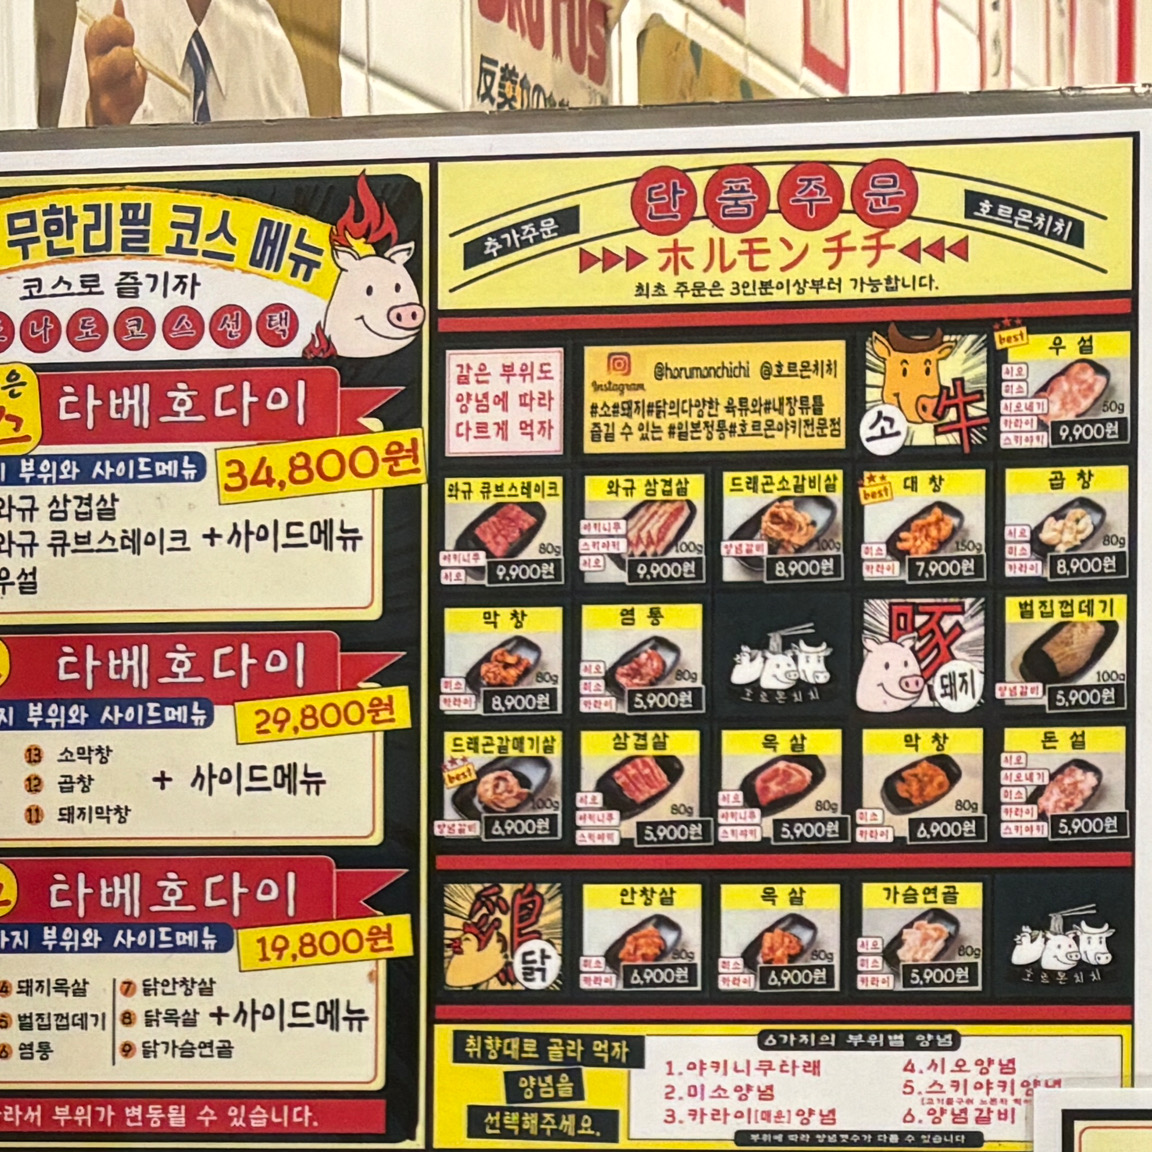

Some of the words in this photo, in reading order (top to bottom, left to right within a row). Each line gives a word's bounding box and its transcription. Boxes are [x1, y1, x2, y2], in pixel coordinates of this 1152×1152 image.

[645, 172, 908, 222] 단품주문
[974, 200, 1074, 242] 호르몬치치
[7, 202, 152, 261] 무한리필
[165, 204, 238, 263] 코스
[249, 216, 325, 282] 메뉴
[484, 218, 559, 258] 추가주문
[20, 273, 104, 301] 코스로
[114, 270, 201, 300] 즐기자
[634, 282, 665, 298] 최초
[674, 281, 725, 298] 주문은
[731, 276, 842, 297] 3인분이상부터
[850, 275, 939, 293] 가능합니다.
[456, 362, 492, 385] 같은
[500, 361, 555, 385] 부위도
[58, 379, 306, 431] 타베호다이
[456, 392, 509, 413] 양념에
[519, 391, 555, 412] 따라
[456, 420, 509, 442] 다르게
[519, 419, 555, 440] 먹자
[1058, 424, 1119, 440] 9,900원
[223, 437, 422, 493] 34,800원
[47, 528, 191, 557] 큐브스테이크
[1018, 599, 1115, 619] 벌집껍데기
[57, 642, 305, 690] 타베호다이
[27, 703, 89, 727] 부위와
[100, 702, 208, 727] 사이드메뉴
[254, 694, 395, 736] 29,800원
[57, 745, 113, 764] 소막창
[191, 762, 327, 797] 사이드메뉴
[57, 805, 132, 825] 돼지막창
[49, 872, 296, 919] 타베호다이
[882, 887, 959, 905] 가슴연골
[256, 922, 395, 963] 19,800원
[911, 968, 970, 986] 5,900원
[142, 1040, 234, 1059] 닭가슴연골
[465, 1036, 540, 1061] 취향대로
[546, 1038, 584, 1061] 골라
[592, 1040, 630, 1063] 먹자
[518, 1075, 574, 1099] 양념을
[52, 1105, 115, 1127] 부위가
[124, 1105, 186, 1127] 변동될
[196, 1106, 218, 1127] 수
[228, 1105, 319, 1127] 있습니다.
[485, 1111, 601, 1136] 선택해주세요.
